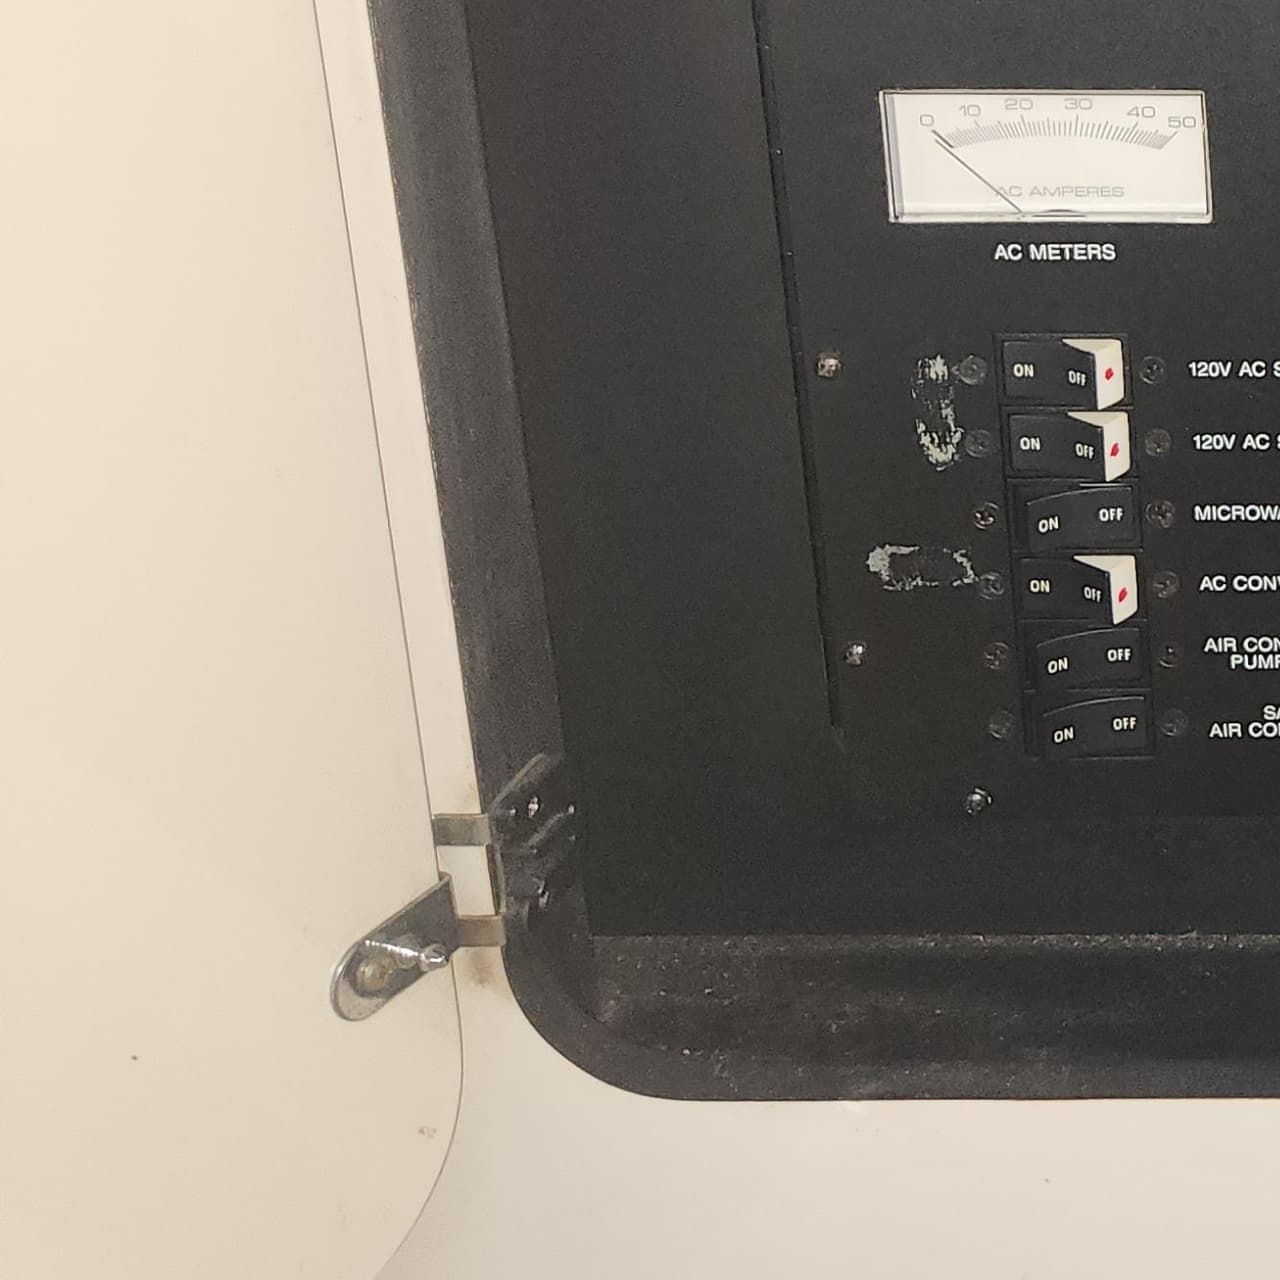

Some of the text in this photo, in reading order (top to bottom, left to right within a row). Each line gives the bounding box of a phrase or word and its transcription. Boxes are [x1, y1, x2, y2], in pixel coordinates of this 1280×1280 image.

[995, 244, 1115, 260] AC METERS
[1014, 364, 1033, 377] ON
[1189, 362, 1231, 377] 120V
[1239, 361, 1265, 377] AC
[1069, 371, 1085, 385] OFF
[1200, 576, 1226, 591] AC
[1204, 638, 1236, 652] AIR
[1210, 723, 1241, 737] AIR
